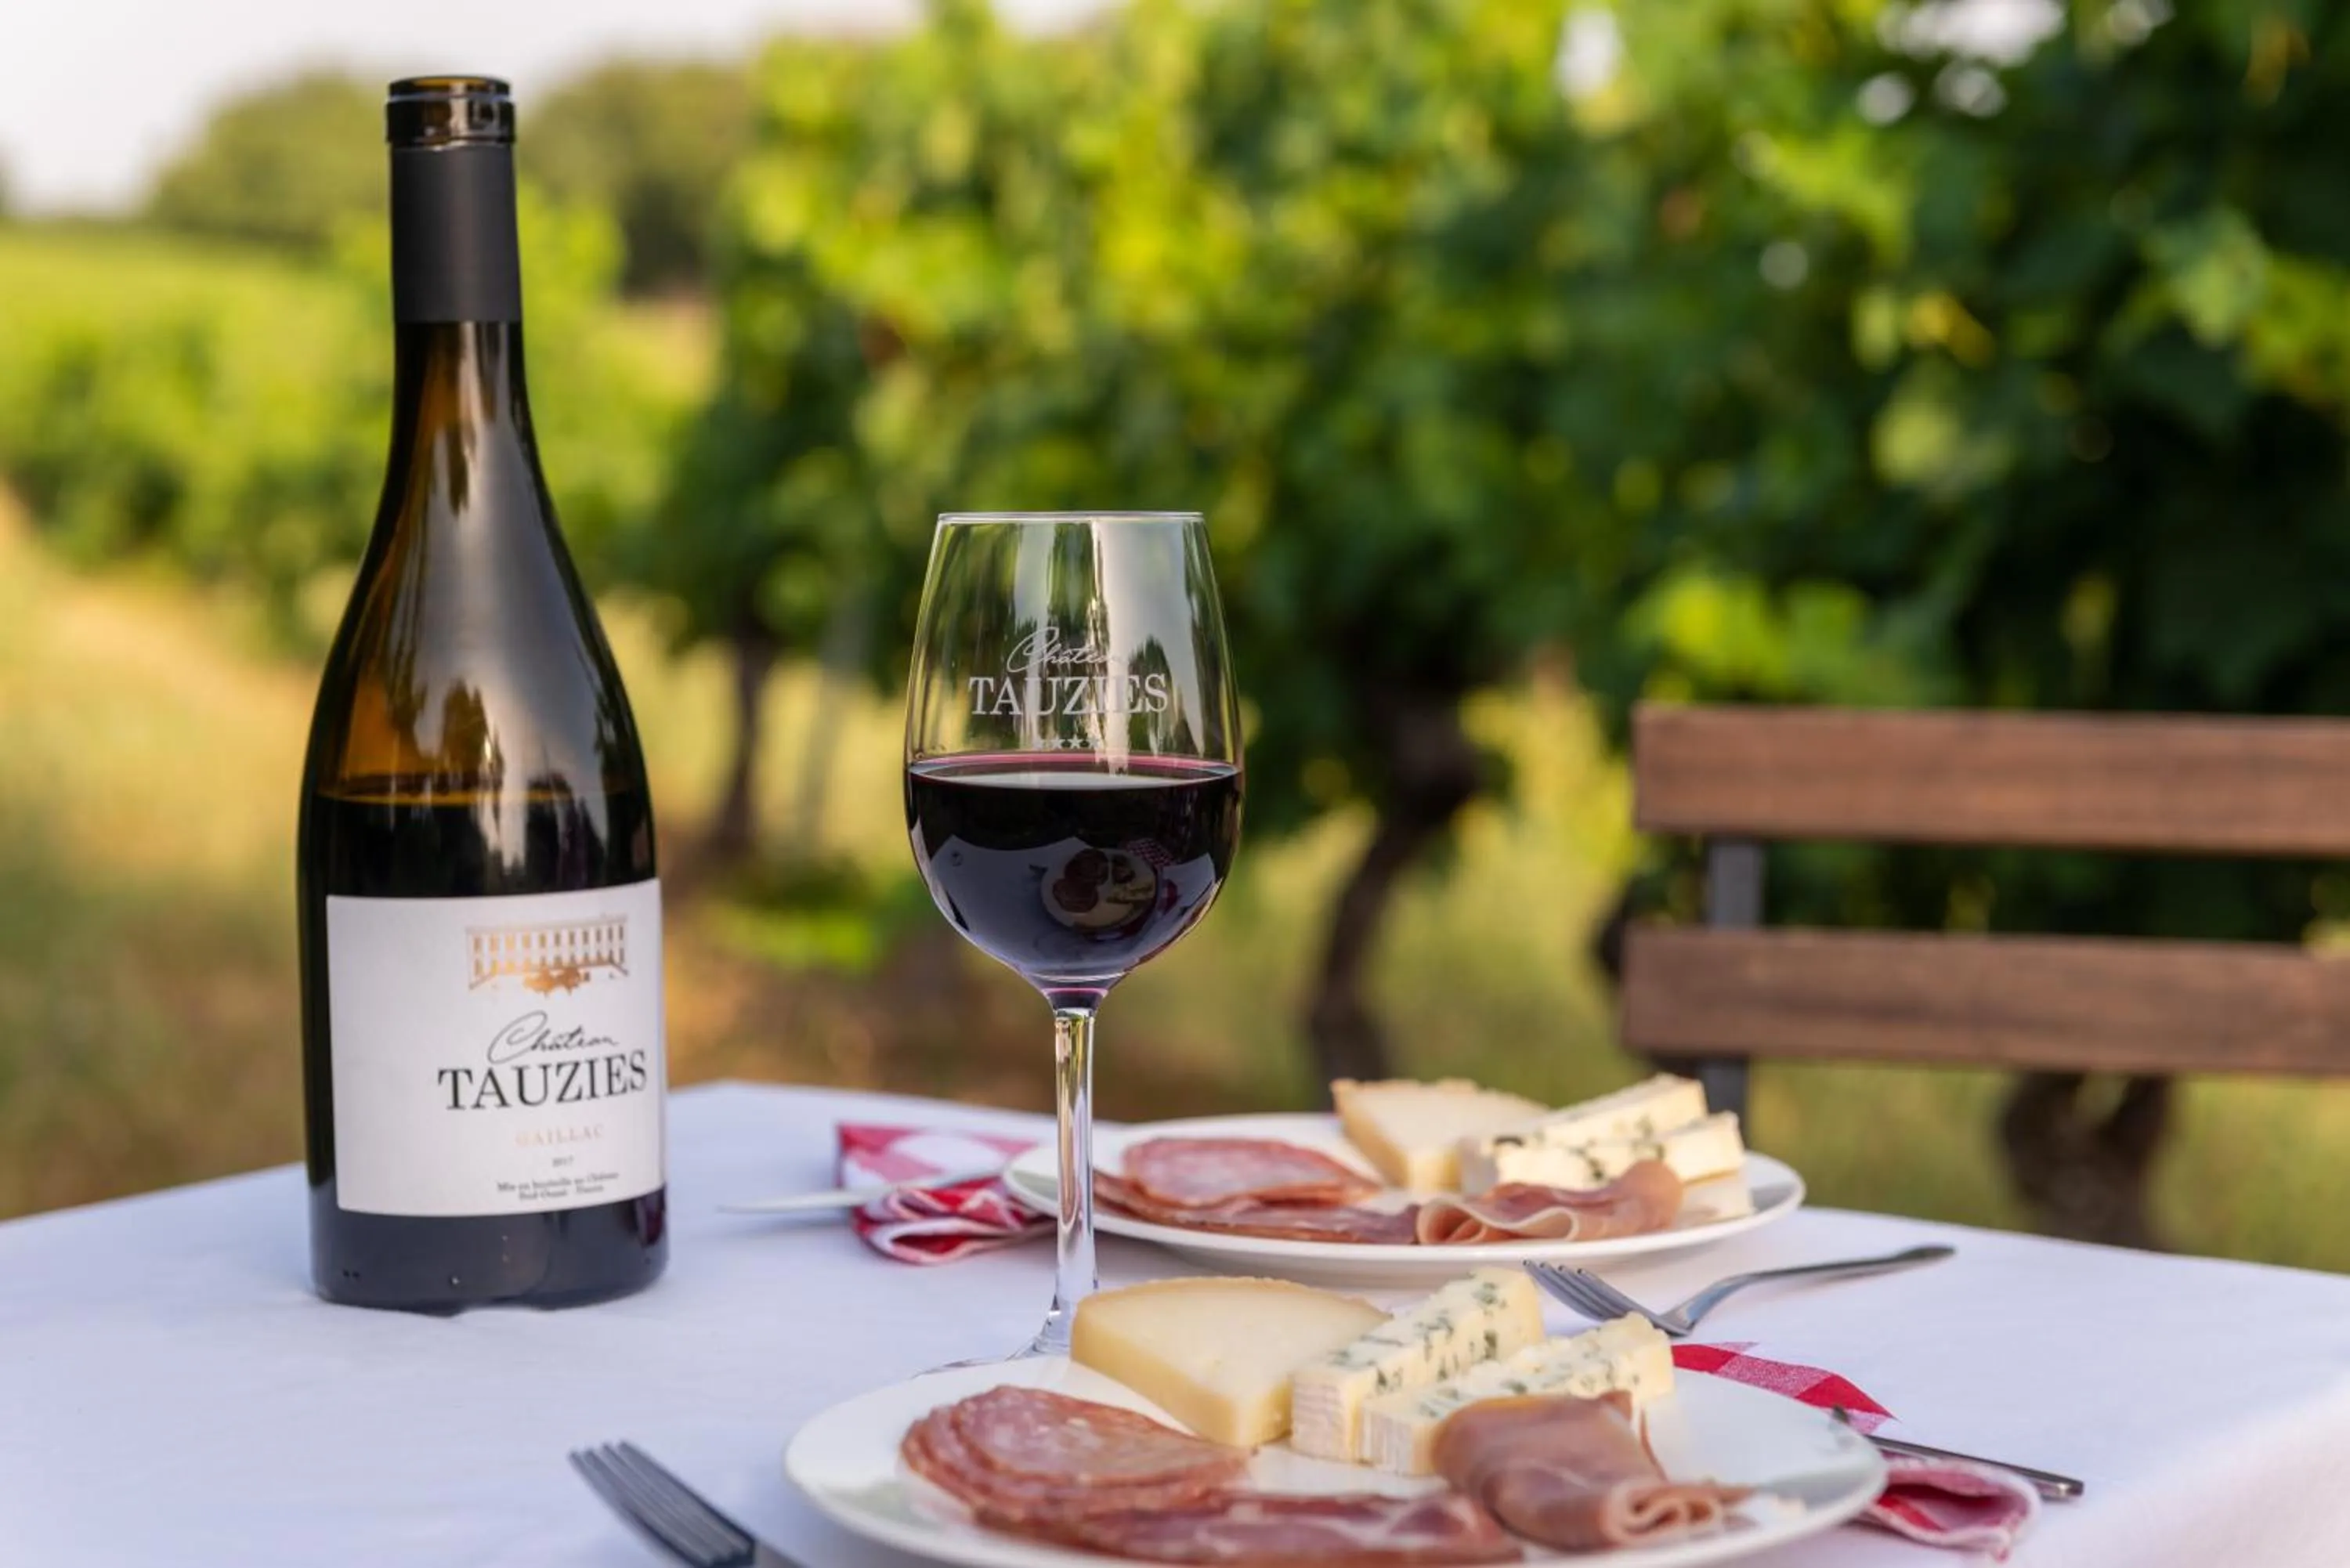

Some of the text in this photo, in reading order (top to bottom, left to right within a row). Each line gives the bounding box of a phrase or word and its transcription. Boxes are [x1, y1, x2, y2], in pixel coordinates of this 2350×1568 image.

[1007, 627, 1129, 672] Châtea
[969, 673, 1168, 714] TAUZIES
[438, 1050, 647, 1110] TAUZIES
